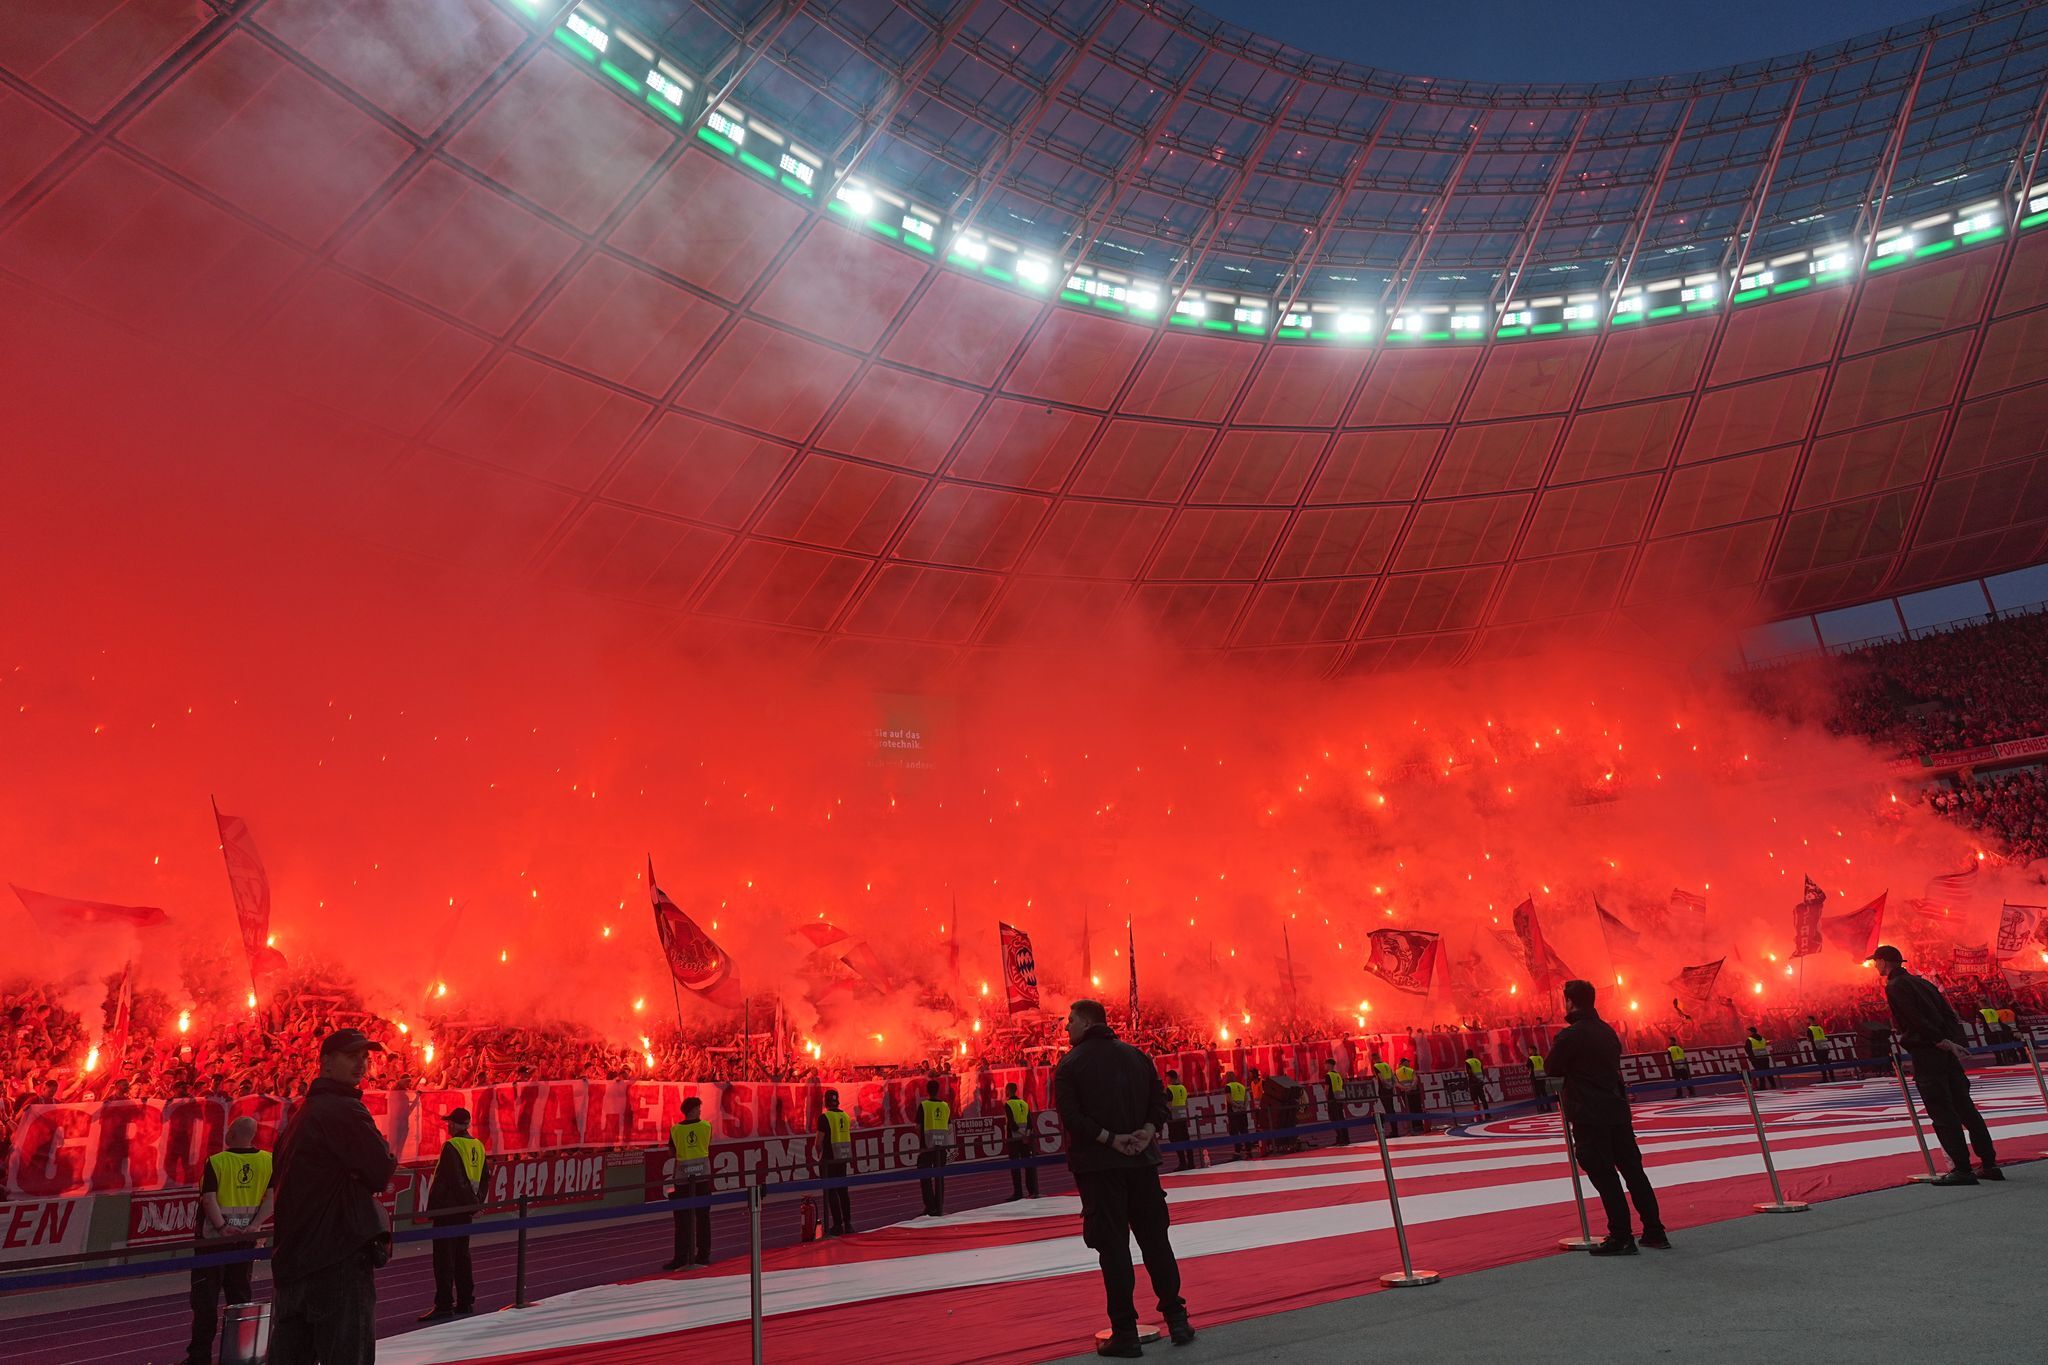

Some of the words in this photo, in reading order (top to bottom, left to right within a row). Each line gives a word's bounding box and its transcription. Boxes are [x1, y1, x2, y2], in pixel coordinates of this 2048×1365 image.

[889, 729, 904, 739] auf
[905, 729, 920, 740] das
[418, 1083, 700, 1158] RIVALEN
[513, 1161, 548, 1200] RED
[553, 1156, 604, 1194] PRIDE
[0, 1200, 76, 1248] EN
